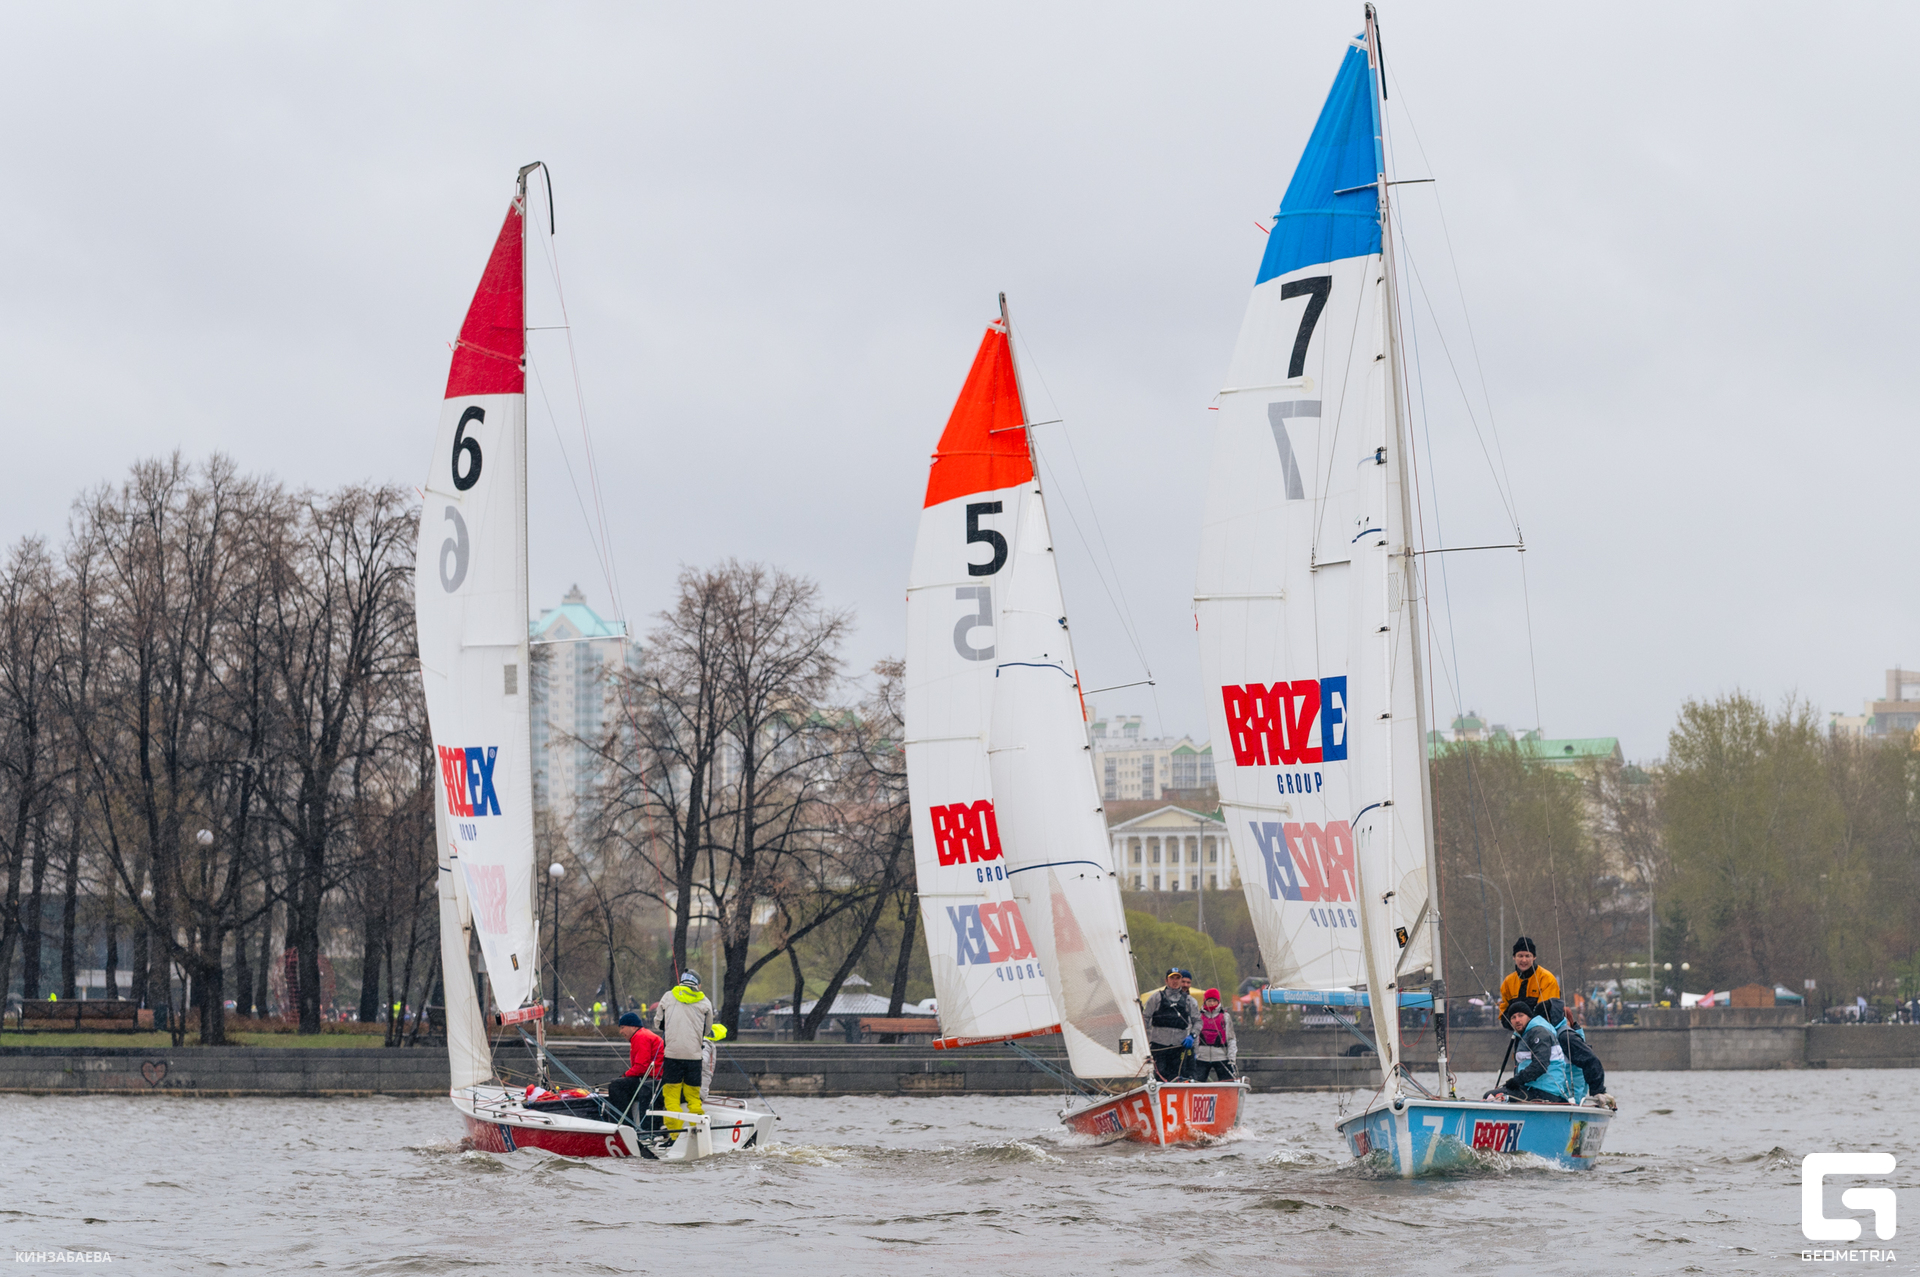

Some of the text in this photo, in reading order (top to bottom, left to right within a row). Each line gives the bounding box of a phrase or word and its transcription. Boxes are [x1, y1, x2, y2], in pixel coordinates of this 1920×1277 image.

[1281, 275, 1332, 379] 7
[452, 405, 486, 491] 6
[966, 501, 1008, 577] 5
[1221, 675, 1348, 767] BROZE
[1276, 771, 1323, 794] GROUP
[930, 798, 1004, 867] BRO
[731, 1120, 743, 1143] 6
[1132, 1099, 1152, 1138] 5
[1167, 1094, 1178, 1132] 5
[605, 1135, 625, 1158] 6
[1422, 1115, 1444, 1165] 7
